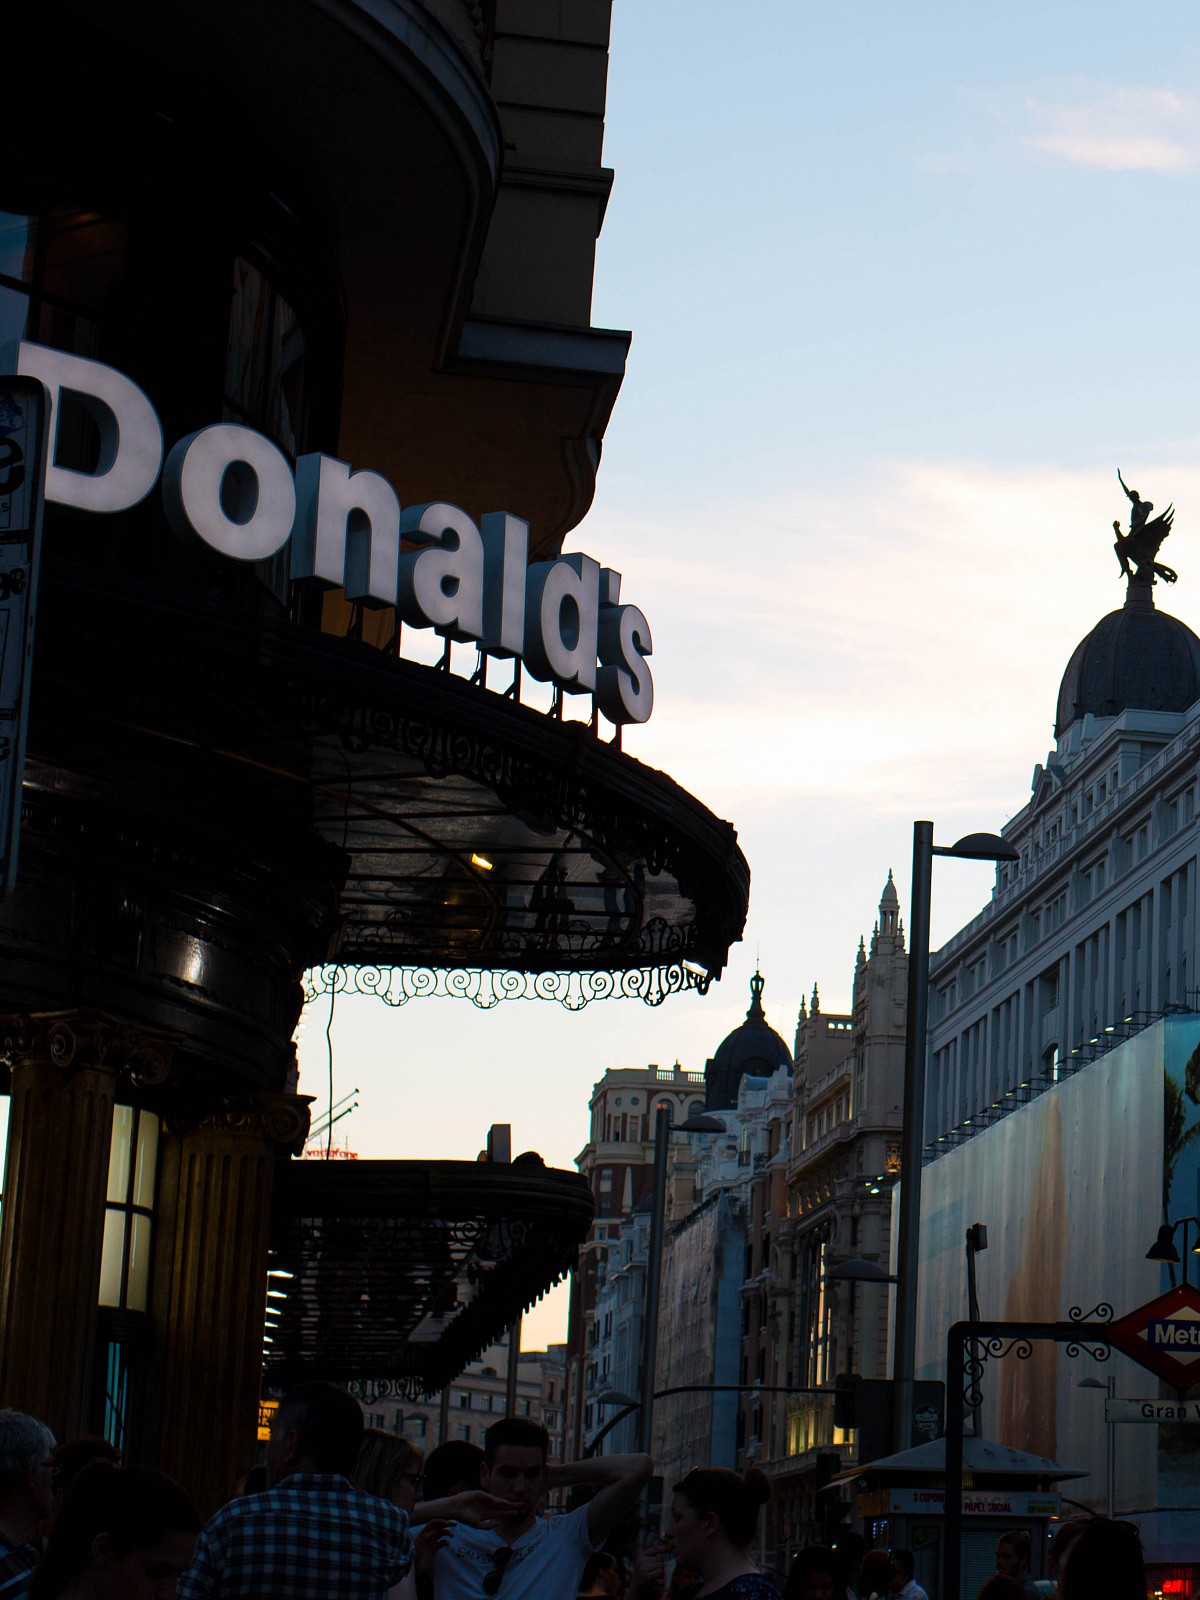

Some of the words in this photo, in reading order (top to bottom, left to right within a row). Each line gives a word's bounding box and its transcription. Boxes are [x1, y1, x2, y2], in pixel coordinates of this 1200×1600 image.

[17, 340, 654, 724] Donald's
[1141, 1403, 1187, 1419] Gran
[964, 1502, 986, 1512] PAPEL
[987, 1503, 1012, 1514] SOCIAL
